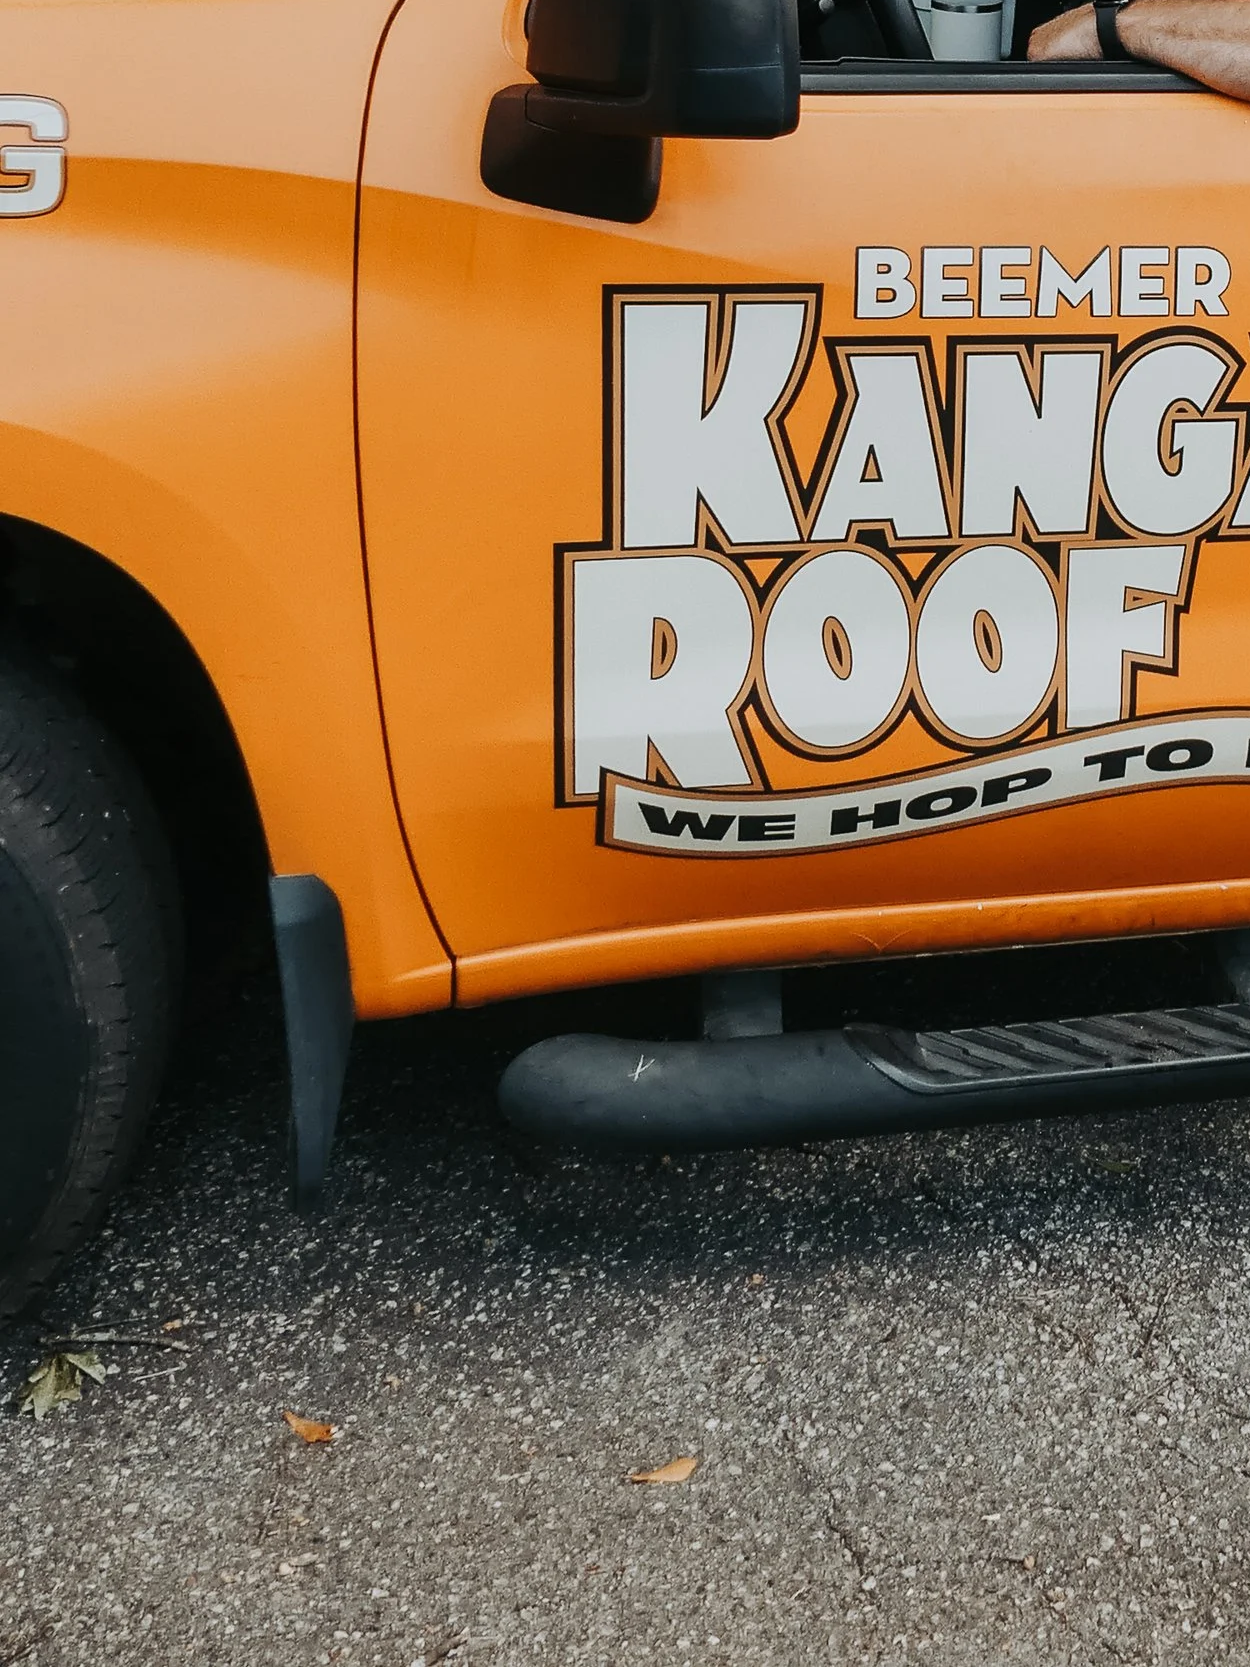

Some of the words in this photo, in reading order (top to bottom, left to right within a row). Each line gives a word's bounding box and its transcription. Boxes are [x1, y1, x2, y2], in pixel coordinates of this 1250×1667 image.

[855, 245, 1232, 319] BEEMER
[564, 539, 1193, 798] ROOF
[636, 802, 797, 843] WE
[829, 767, 1053, 836] HOP
[1083, 738, 1216, 783] TO
